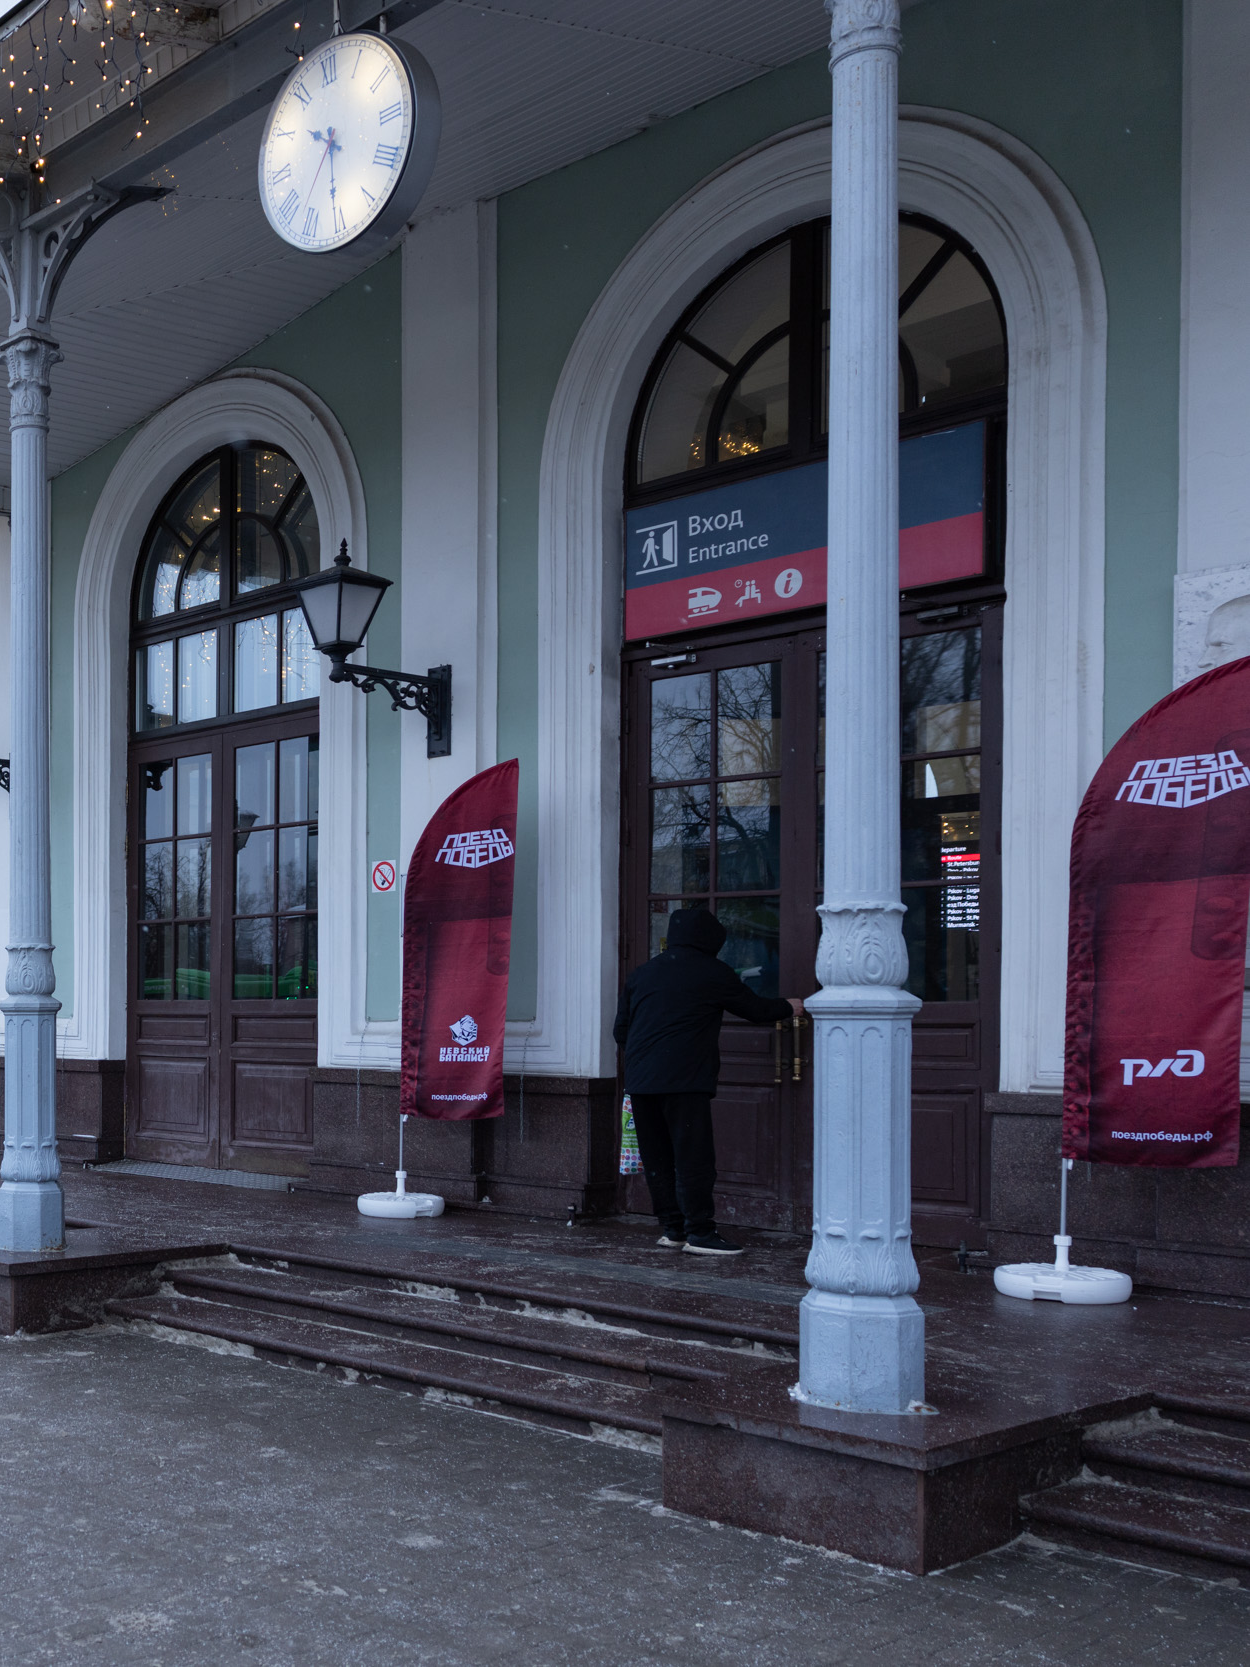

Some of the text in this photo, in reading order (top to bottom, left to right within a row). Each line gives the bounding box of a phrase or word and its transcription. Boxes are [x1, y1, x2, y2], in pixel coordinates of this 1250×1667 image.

[320, 53, 338, 89] XII
[293, 82, 312, 111] XI
[379, 101, 402, 127] III
[276, 127, 296, 141] X
[279, 188, 300, 226] VIII
[301, 206, 319, 238] VII
[688, 509, 744, 537] Вход
[688, 533, 769, 564] Entrance
[1127, 749, 1244, 781] ПОЕЗД
[1114, 766, 1250, 808] ПОБЕДЫ
[442, 828, 509, 849] ПОЕЗД
[434, 841, 515, 869] ПОБЕДЫ
[439, 1053, 490, 1062] БАТАЛИСТ
[440, 1045, 490, 1054] НЕВСКИЙ
[1111, 1130, 1213, 1143] поездпобеды.рф
